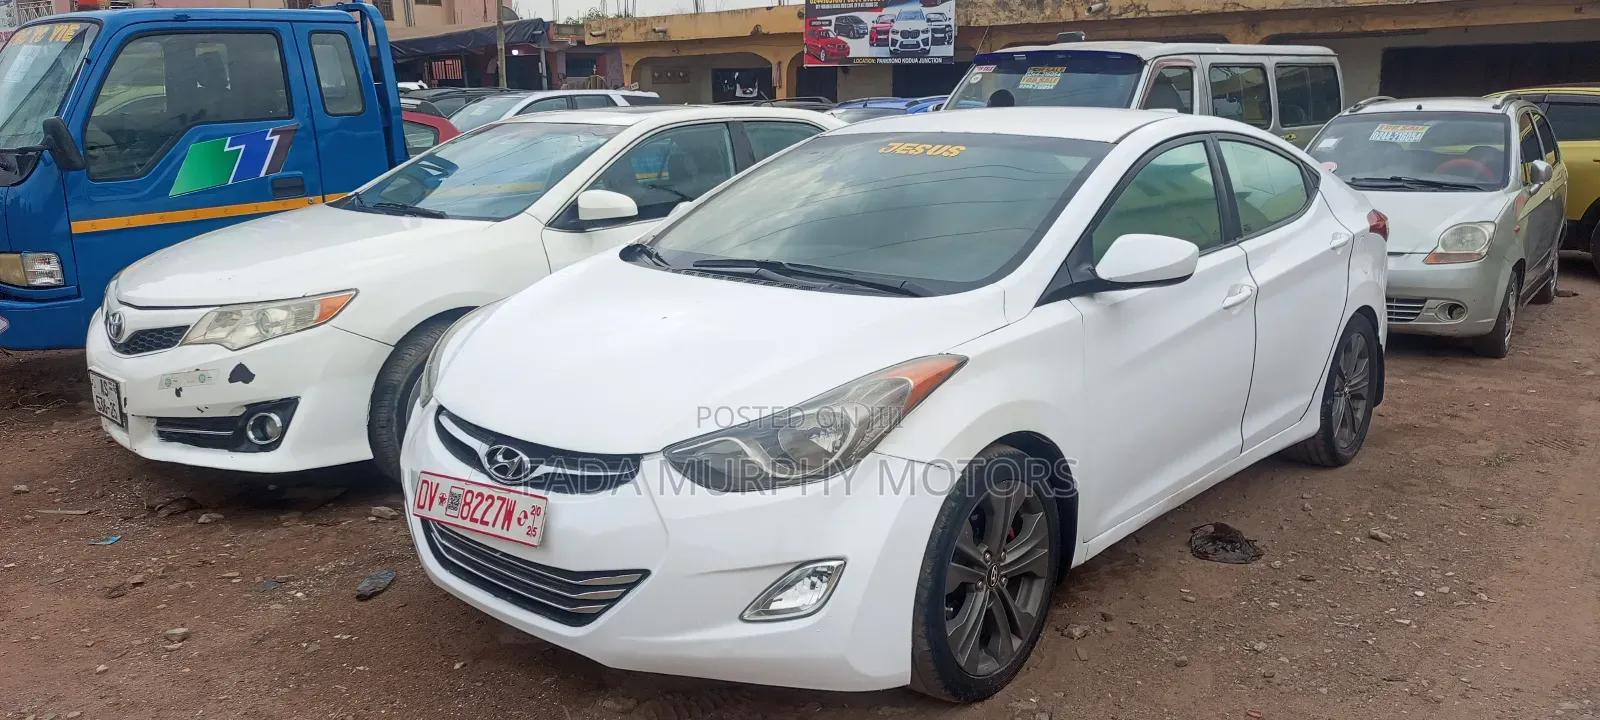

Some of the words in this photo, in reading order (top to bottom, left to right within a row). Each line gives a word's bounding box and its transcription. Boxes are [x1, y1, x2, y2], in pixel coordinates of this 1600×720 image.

[878, 142, 967, 157] JESUS
[416, 479, 439, 511] DV
[460, 489, 517, 531] 8227W
